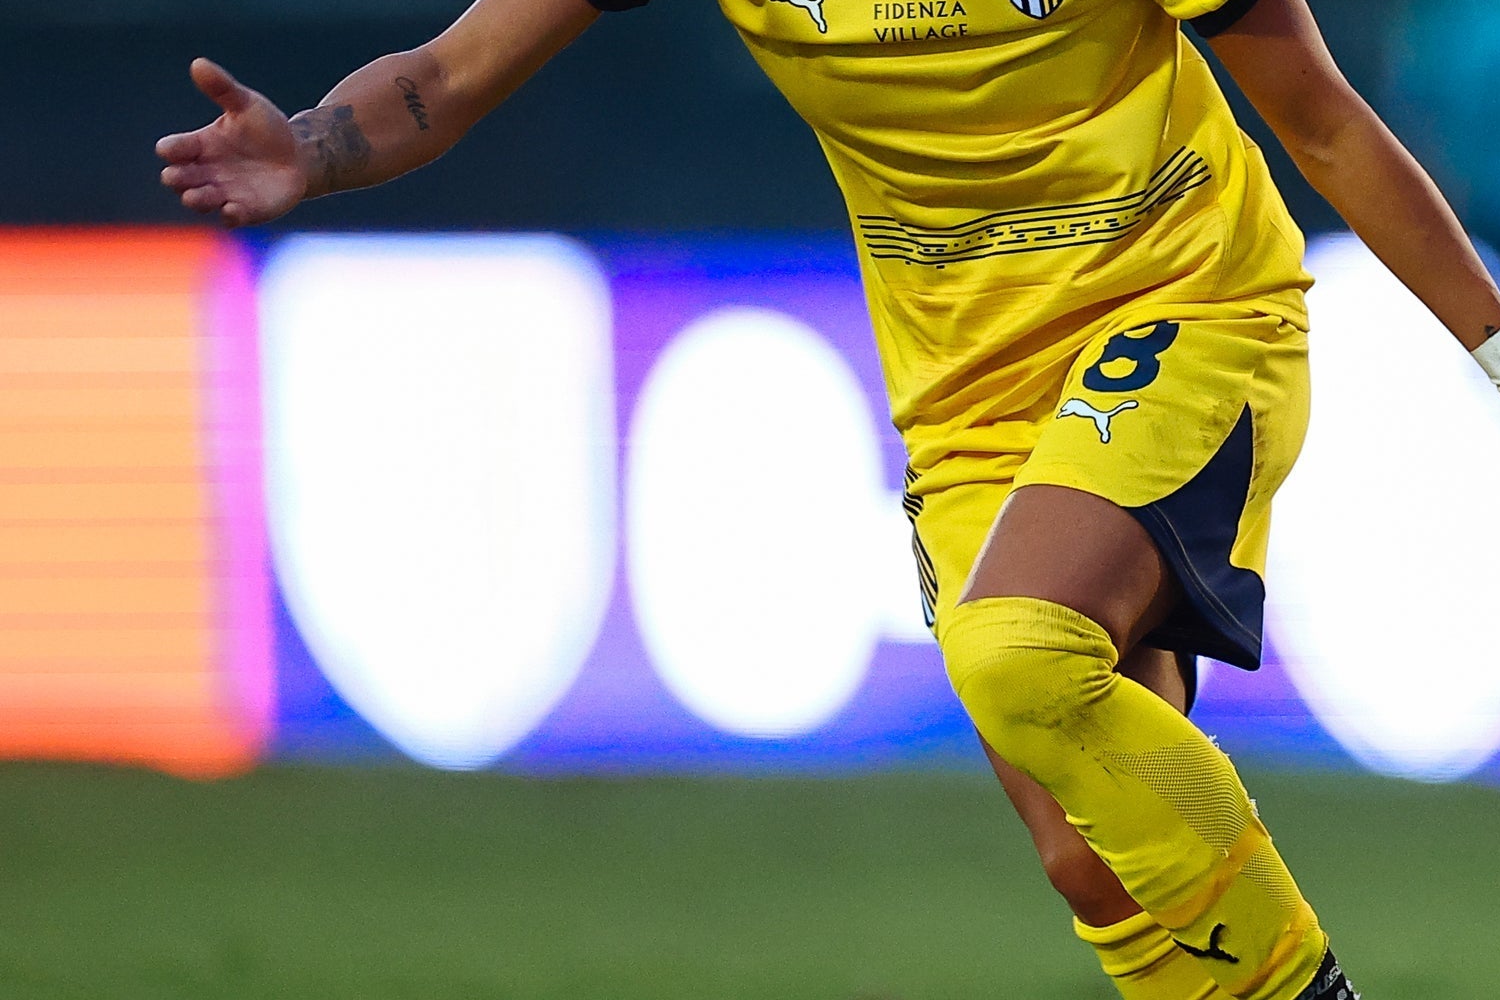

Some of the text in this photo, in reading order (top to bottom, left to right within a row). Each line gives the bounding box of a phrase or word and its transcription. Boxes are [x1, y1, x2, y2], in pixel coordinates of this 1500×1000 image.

[873, 0, 967, 20] FIDENZA
[873, 23, 968, 43] VILLAGE
[1082, 319, 1181, 393] 8
